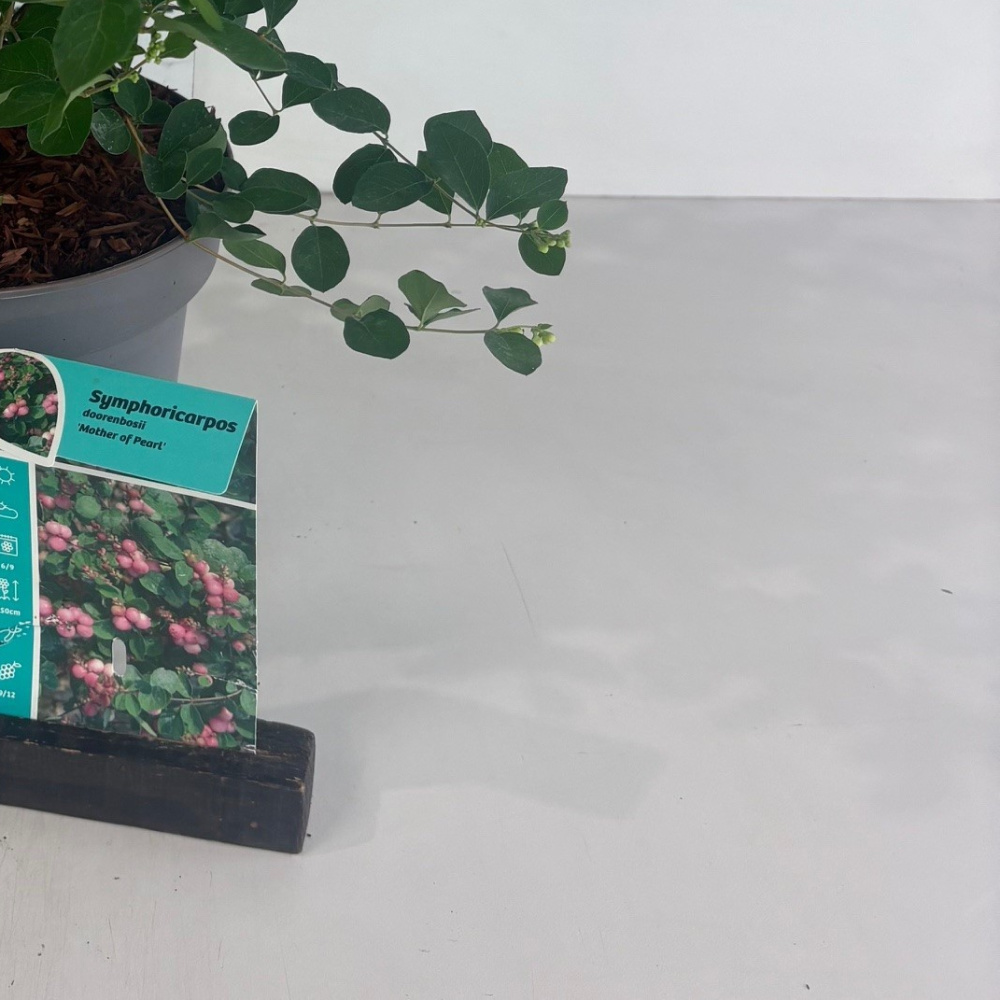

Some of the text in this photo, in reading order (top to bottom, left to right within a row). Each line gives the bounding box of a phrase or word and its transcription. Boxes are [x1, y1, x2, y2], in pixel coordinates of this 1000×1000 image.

[82, 409, 147, 430] doorenbosii
[89, 389, 238, 433] Symphoricarpos
[78, 423, 166, 450] 'Mother of Pearl'
[0, 562, 15, 570] 6/9
